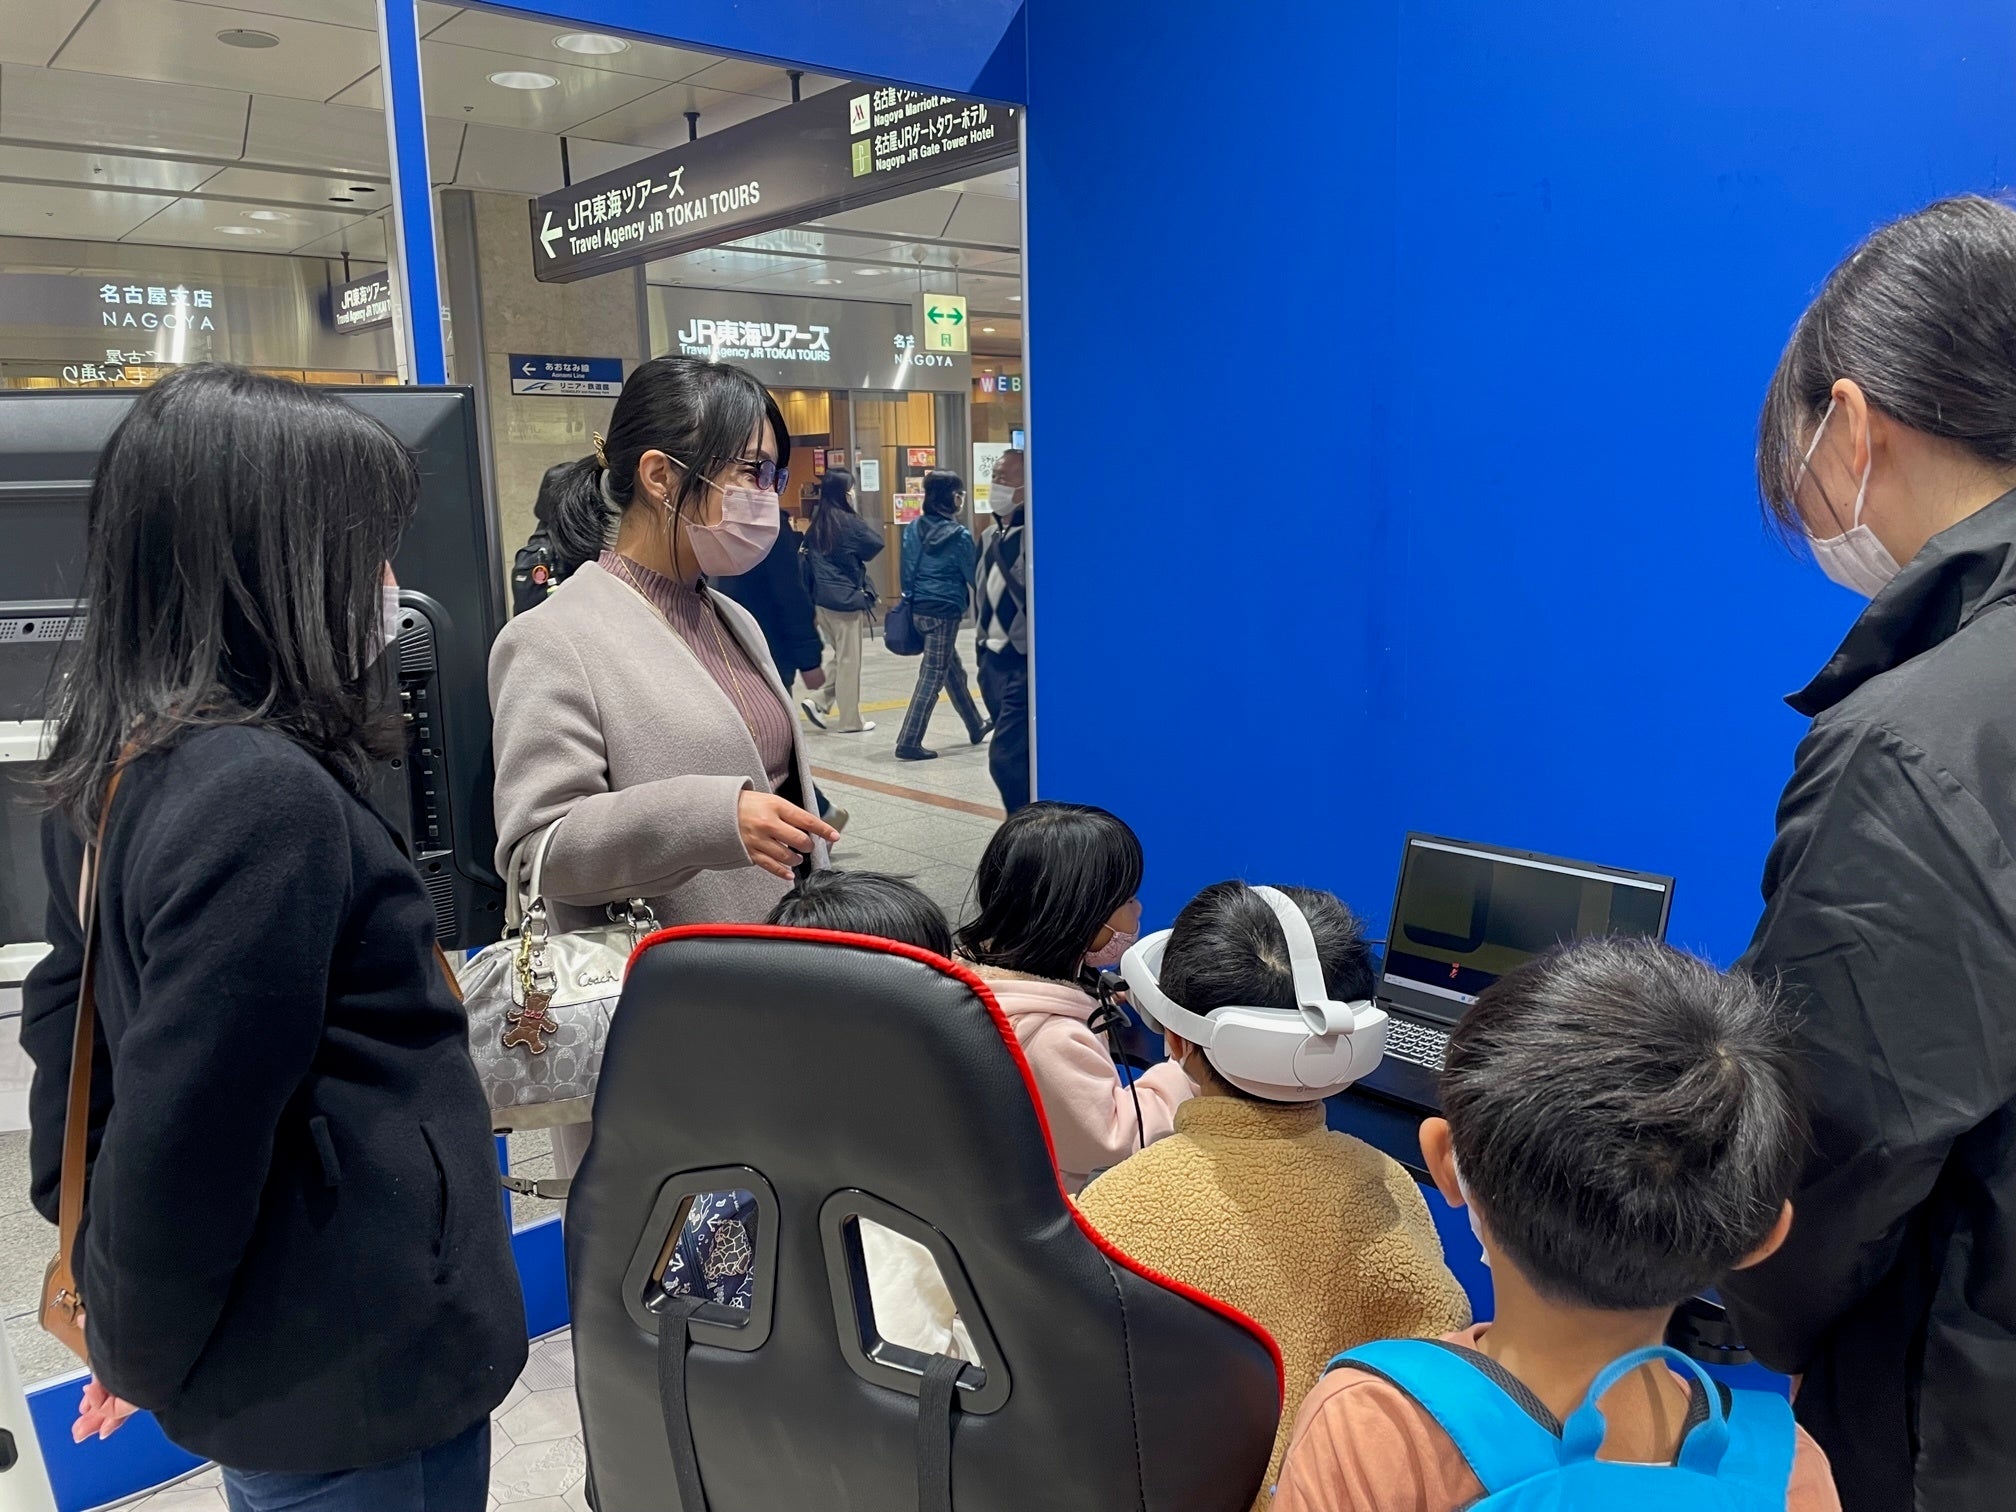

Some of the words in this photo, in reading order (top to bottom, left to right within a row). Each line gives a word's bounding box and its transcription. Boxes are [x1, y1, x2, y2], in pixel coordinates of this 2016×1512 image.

[873, 109, 904, 127] Nagoya
[905, 95, 939, 116] Marriott
[874, 103, 988, 156] 名古屋JRゲートタワーホテル
[875, 155, 906, 172] Nagoya
[907, 149, 919, 163] JR
[920, 144, 940, 159] Gate
[941, 135, 969, 151] Tower
[970, 125, 995, 143] Hotel
[567, 165, 685, 231] JR東海ツアーズ
[569, 229, 602, 255] Travel
[604, 220, 645, 248] Agency
[648, 210, 664, 234] JR
[666, 199, 708, 226] TOKAI
[710, 181, 761, 215] TOURS
[100, 283, 213, 309] 名古屋支店
[102, 311, 215, 331] NAGOYA
[678, 318, 830, 350] JR東海ツアーズ
[679, 343, 712, 357] Travel
[751, 348, 765, 359] JR
[765, 347, 797, 360] TOKAI
[799, 350, 831, 362] TOURS
